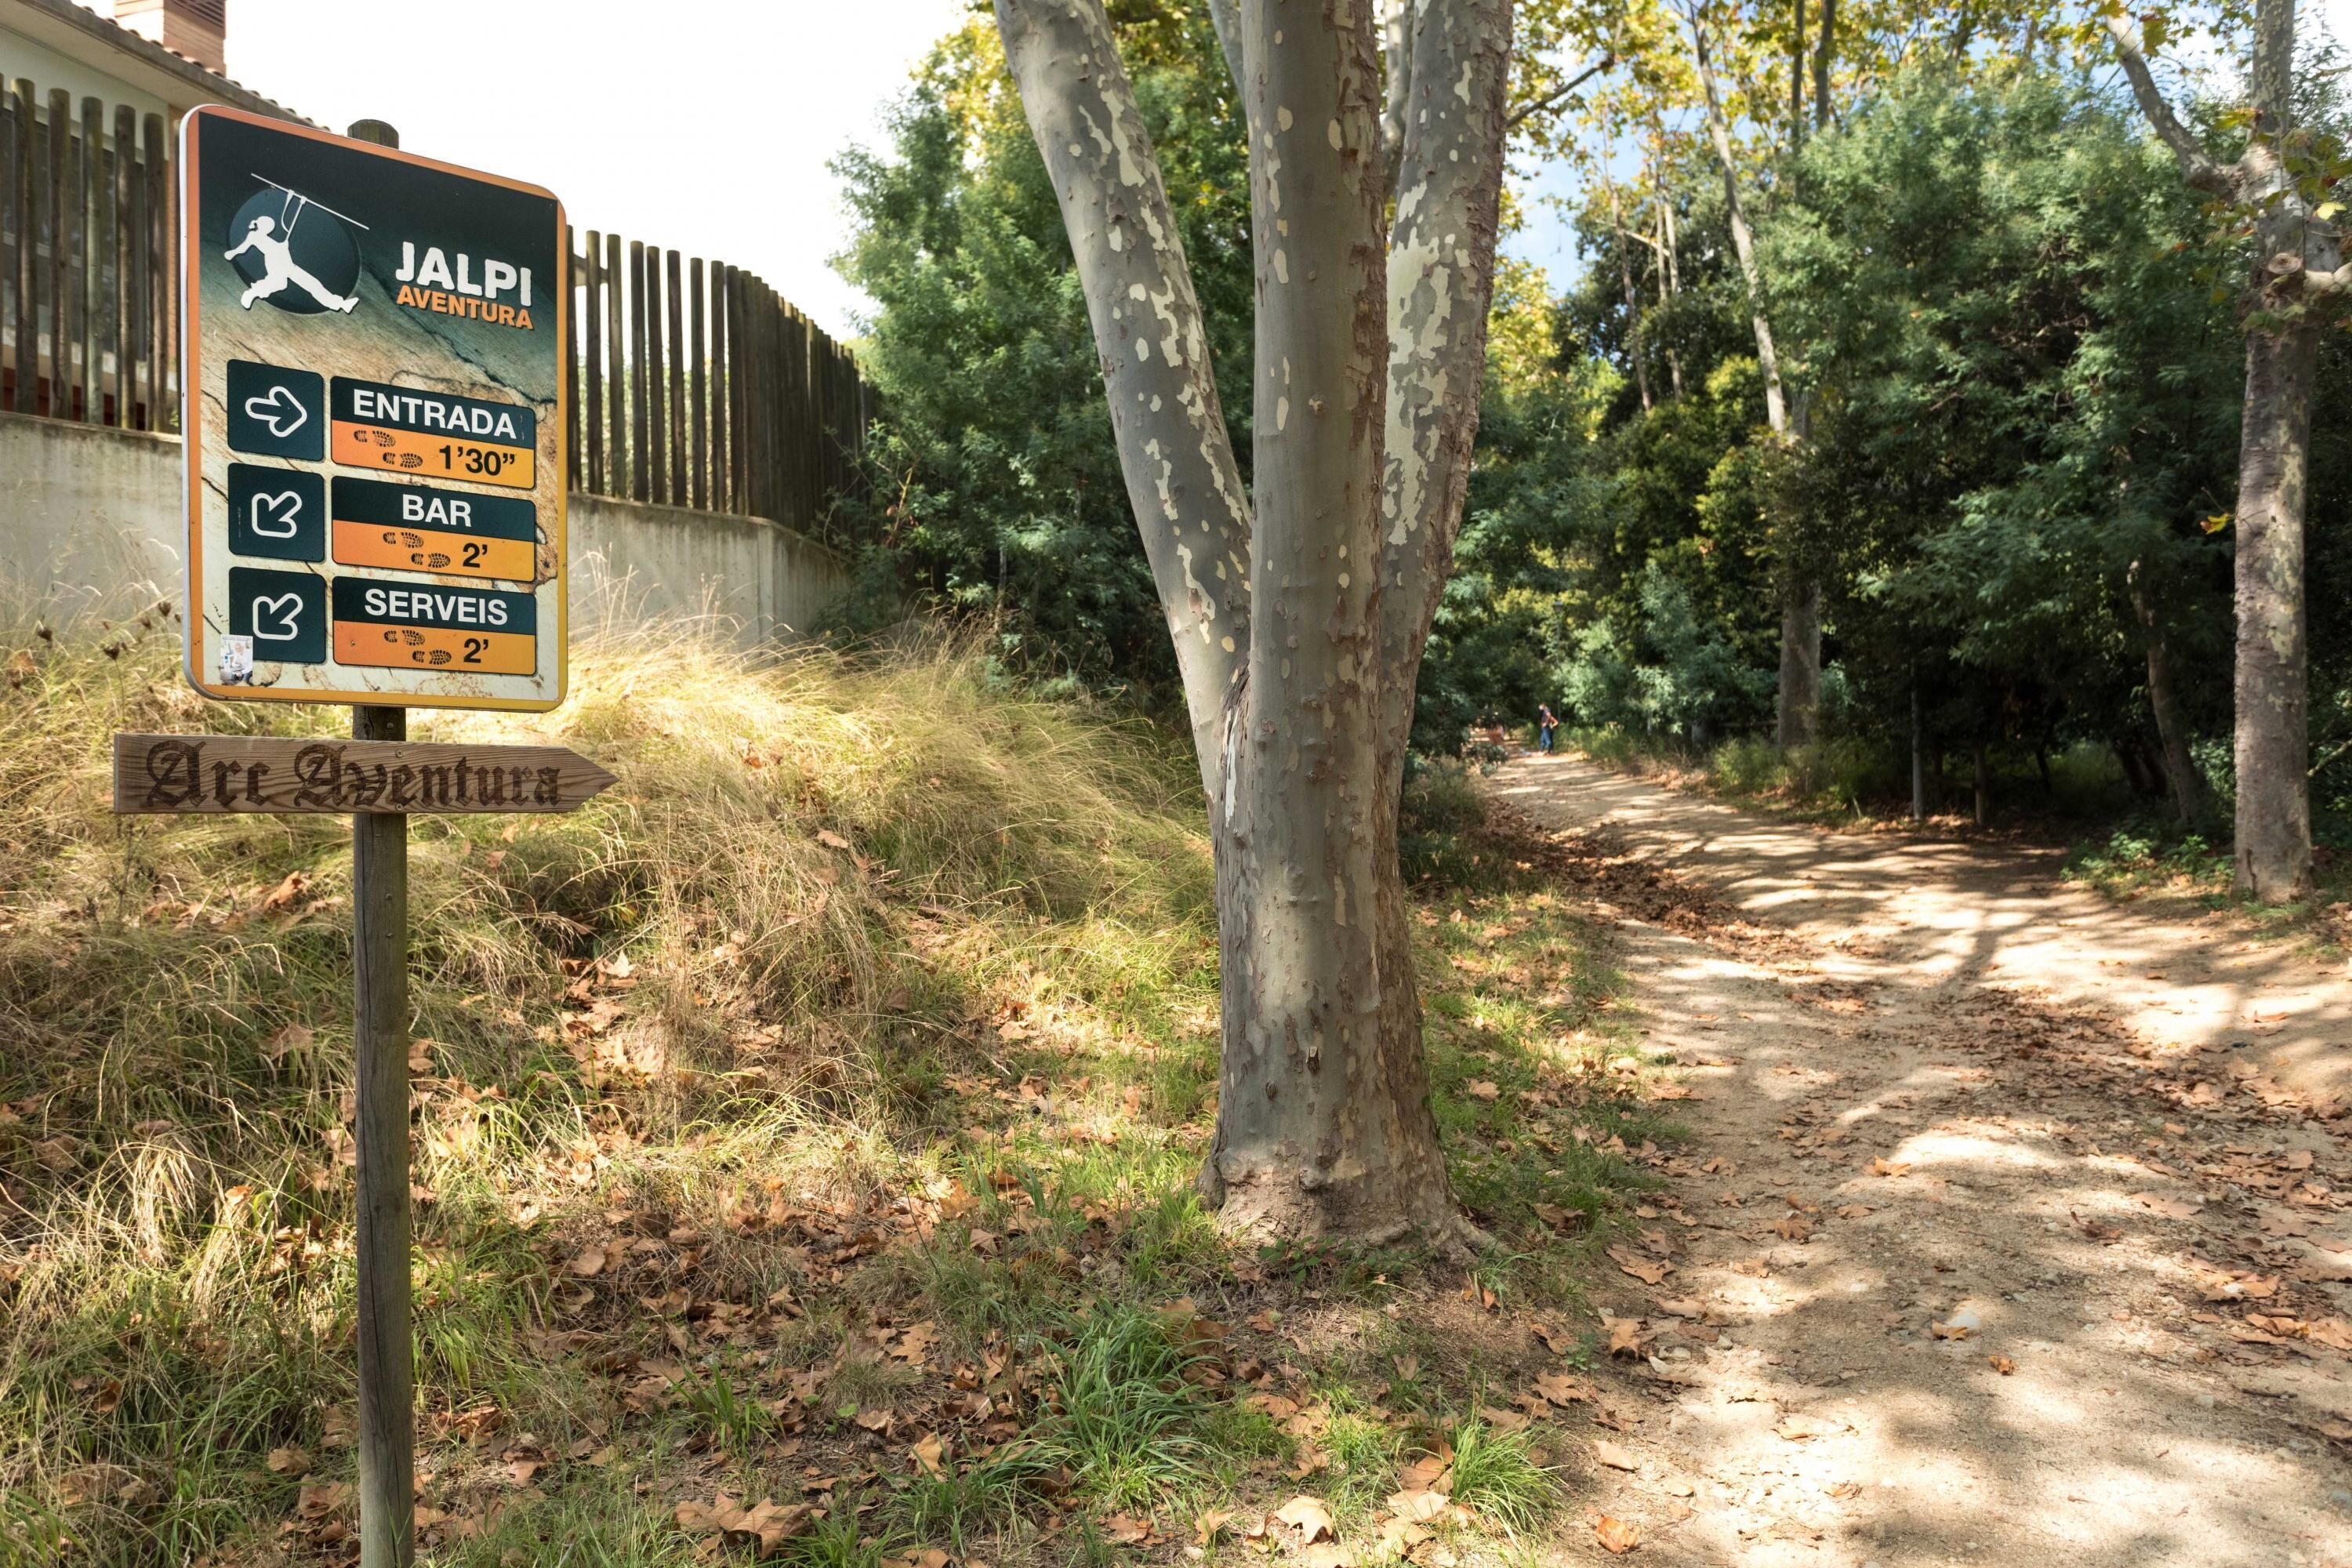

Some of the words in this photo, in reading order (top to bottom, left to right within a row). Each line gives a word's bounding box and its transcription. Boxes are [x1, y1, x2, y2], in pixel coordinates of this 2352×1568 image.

[396, 241, 532, 307] JALPI
[397, 285, 534, 329] AVENTURA
[354, 389, 517, 439] ENTRADA
[402, 494, 471, 527] BAR
[365, 589, 508, 626] SERVEIS
[146, 740, 270, 808] Arc
[293, 744, 561, 808] Aventura
